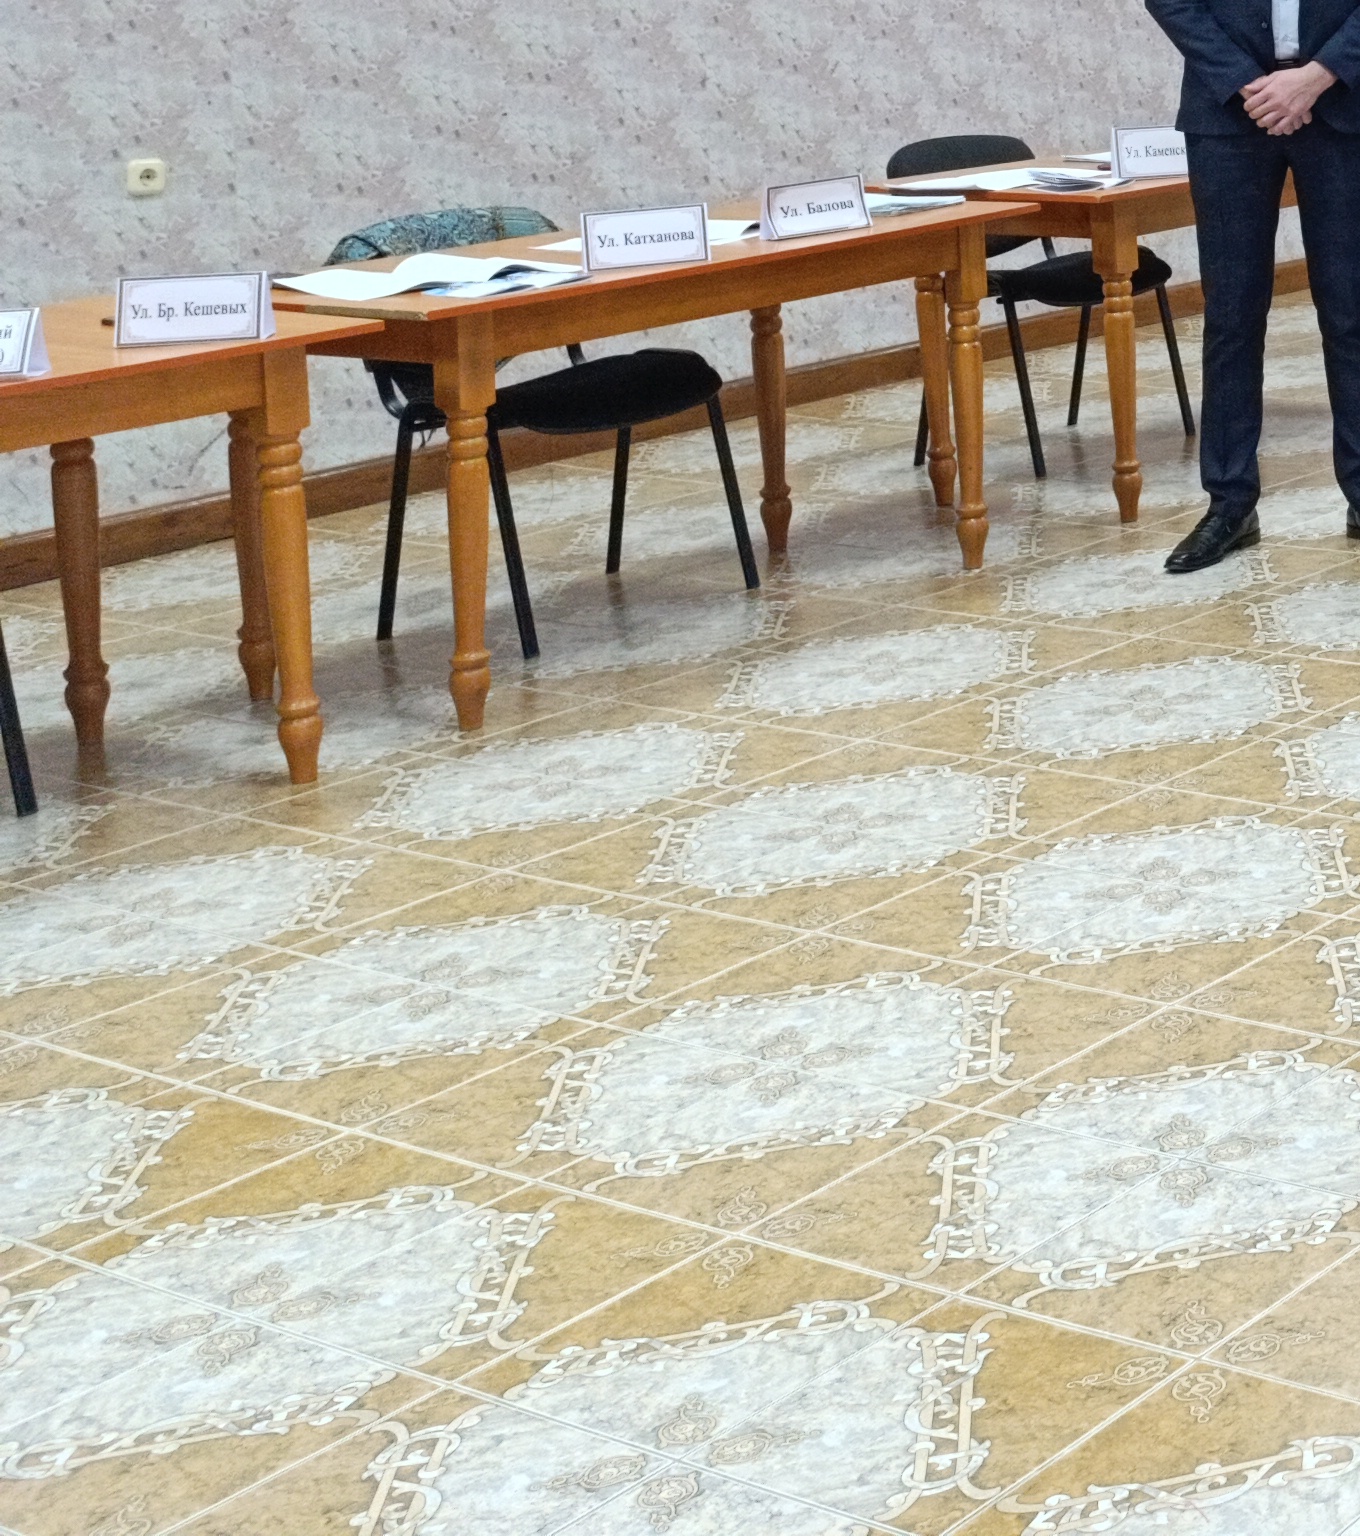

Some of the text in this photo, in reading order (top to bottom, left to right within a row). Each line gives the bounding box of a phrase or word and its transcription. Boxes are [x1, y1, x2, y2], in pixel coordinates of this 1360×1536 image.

[1125, 145, 1187, 159] Ул. Каменск
[780, 199, 855, 219] Ул. Балова
[597, 230, 695, 249] Ул. Катханова
[131, 301, 248, 322] Ул. Бр. Кешевых
